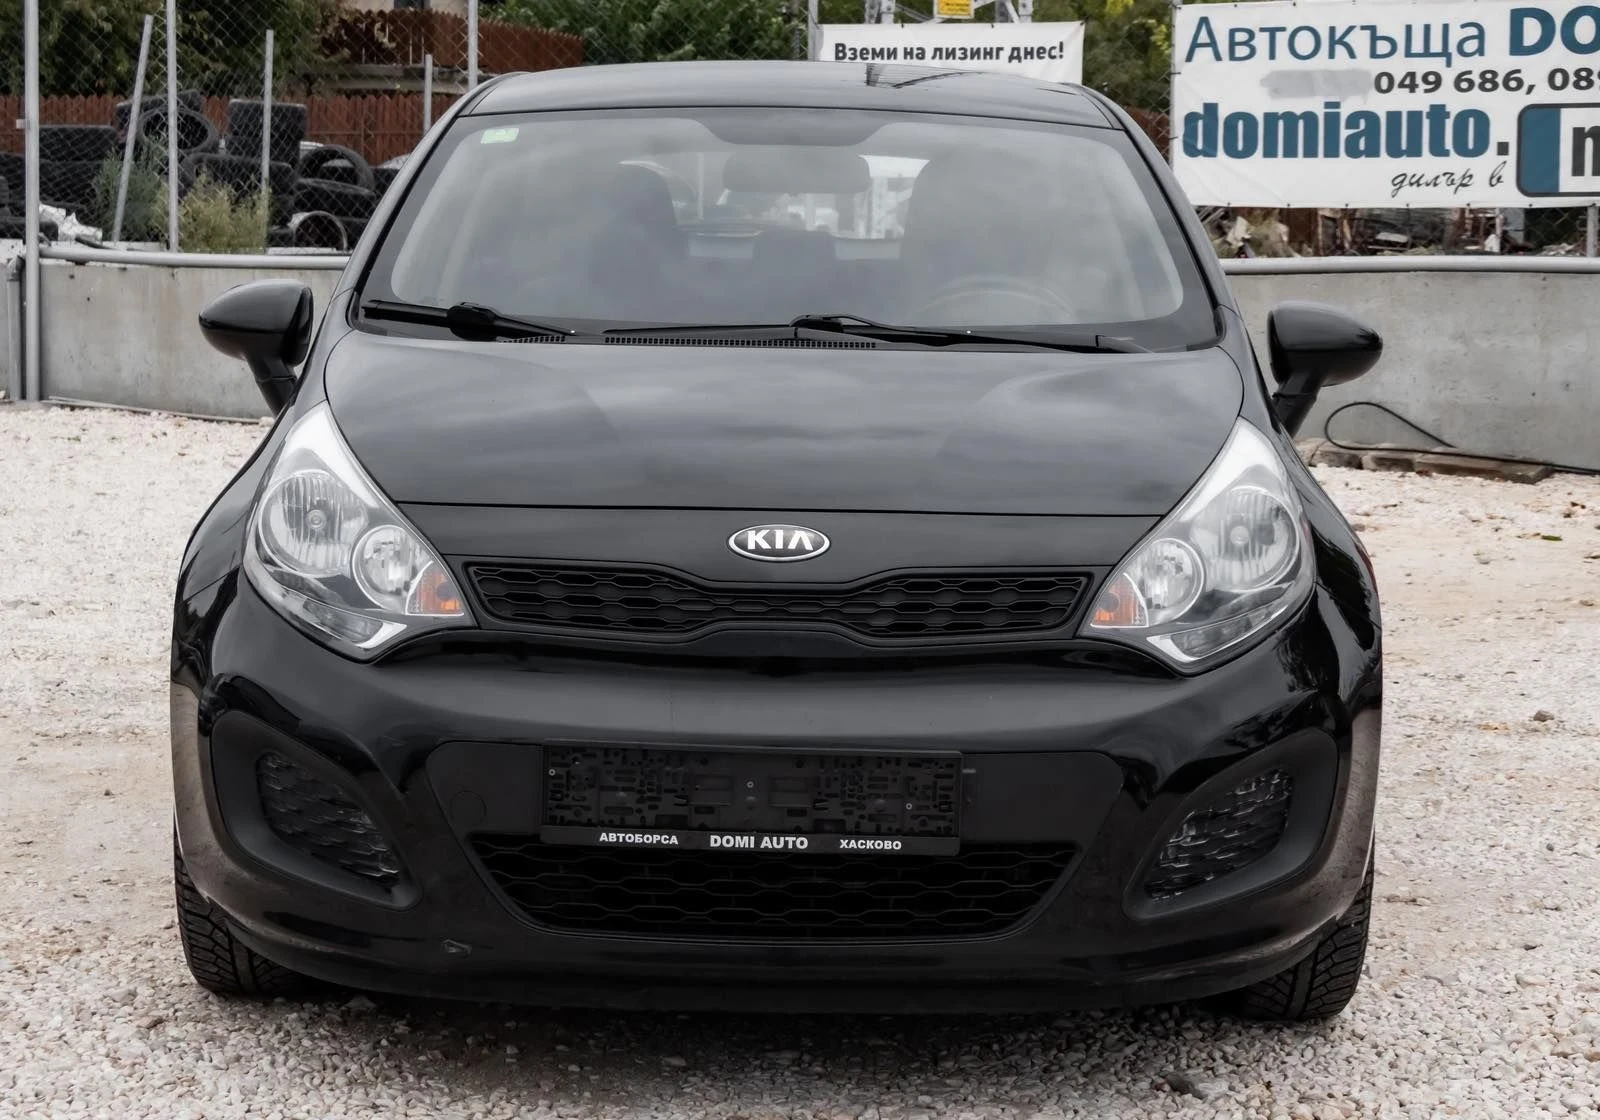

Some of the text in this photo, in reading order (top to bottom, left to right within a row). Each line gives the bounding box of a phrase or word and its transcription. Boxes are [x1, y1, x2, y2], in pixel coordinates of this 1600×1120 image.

[1185, 5, 1600, 68] Автокъща DO
[834, 41, 1064, 63] Вземи на лизинг днес!
[1373, 67, 1600, 95] 049 686, 08
[1182, 101, 1510, 159] domiauto.
[1391, 160, 1507, 198] дилър в
[746, 529, 814, 551] KIA
[599, 832, 679, 845] АВТОБОРСА
[709, 834, 809, 850] DOMI AUTO
[839, 839, 902, 850] ХАСКОВО
